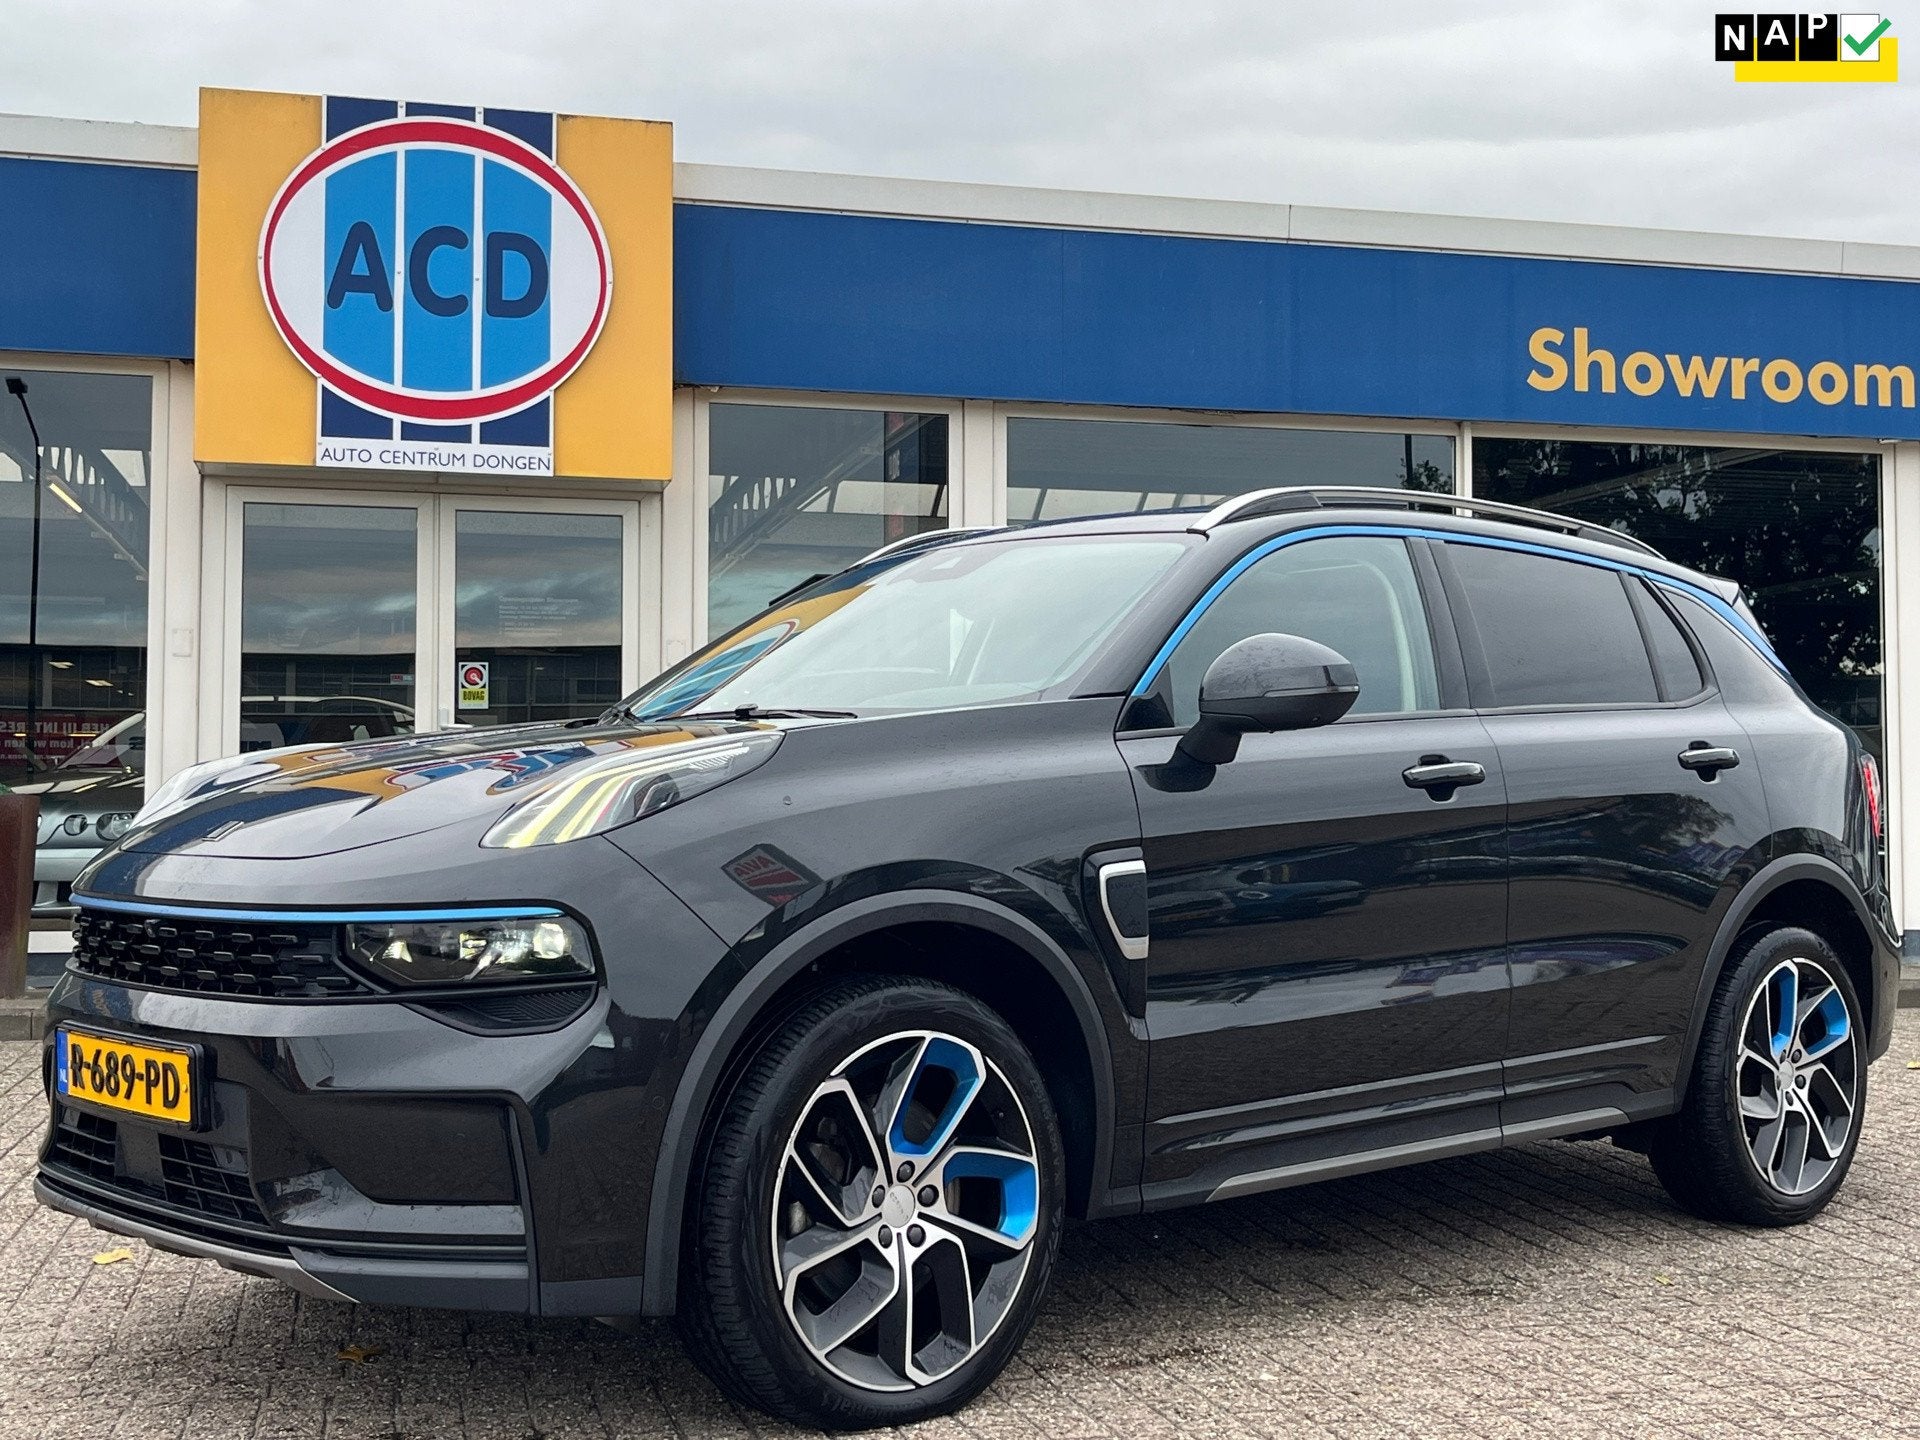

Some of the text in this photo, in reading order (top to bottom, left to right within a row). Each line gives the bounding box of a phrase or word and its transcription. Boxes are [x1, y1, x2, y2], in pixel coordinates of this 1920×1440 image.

[325, 220, 549, 319] ACD
[1526, 327, 1916, 408] Showroom
[320, 448, 550, 471] AUTO CENTRUM DONGEN
[462, 690, 486, 701] BOVAG
[70, 1043, 180, 1109] R-689-PD
